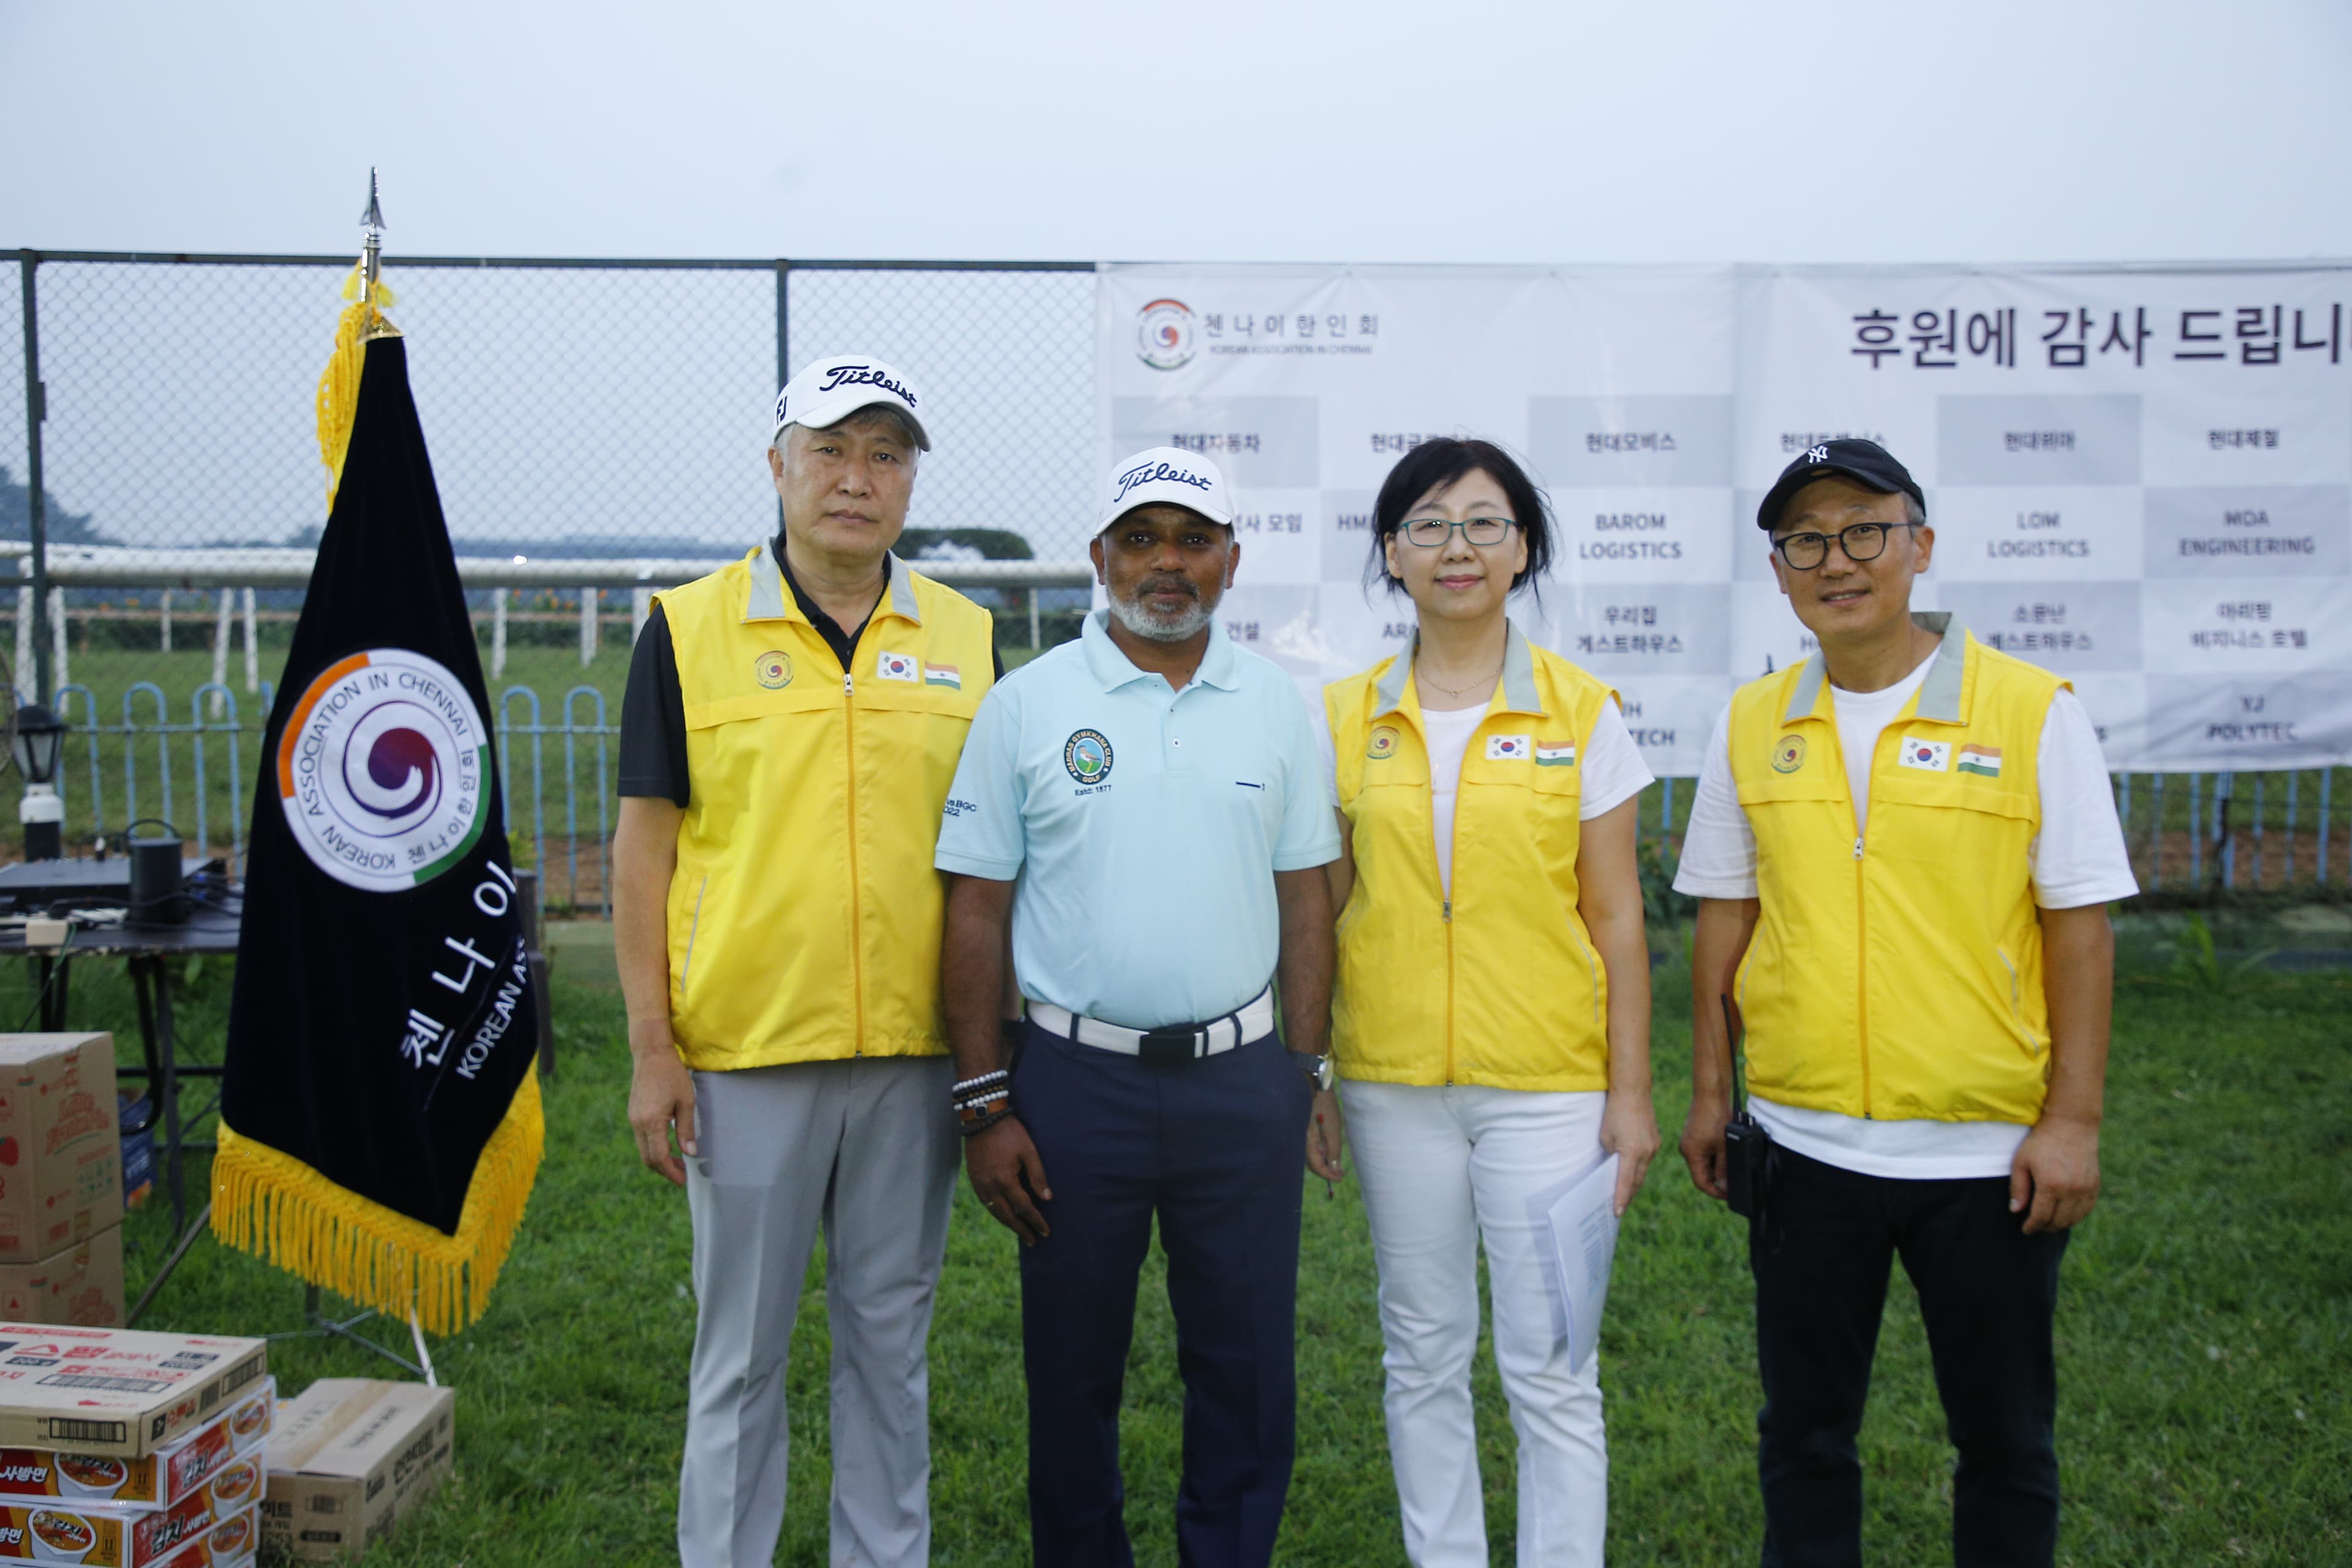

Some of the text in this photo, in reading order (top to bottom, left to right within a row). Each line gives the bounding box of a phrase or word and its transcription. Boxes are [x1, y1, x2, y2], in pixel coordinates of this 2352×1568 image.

[1851, 304, 2352, 368] 후원에 감사 드립니
[820, 365, 917, 407] Titleist
[1173, 434, 1259, 454] 현대자동차
[1586, 432, 1677, 453] 현대모비스
[2207, 430, 2279, 451] 현대제철
[1808, 446, 1828, 464] NY
[1114, 461, 1212, 503] Titleist
[1268, 513, 1302, 533] 모임
[1596, 514, 1665, 532] BAROM
[1580, 542, 1682, 560] LOGISTICS
[1988, 540, 2090, 558] LOGISTICS
[2179, 537, 2315, 556] ENGINEERING
[1605, 605, 1656, 626] 우리집
[1577, 634, 1683, 655] 게스트하우스
[1988, 632, 2093, 651] 게스트하우스
[2272, 629, 2307, 649] 호텔
[2206, 722, 2298, 741] POLYTEC
[300, 673, 469, 871] KOREAN ASSOCIATION IN CHENNAI
[1082, 774, 1101, 783] GOLF
[956, 800, 977, 812] BGC
[456, 981, 523, 1080] KOREAN
